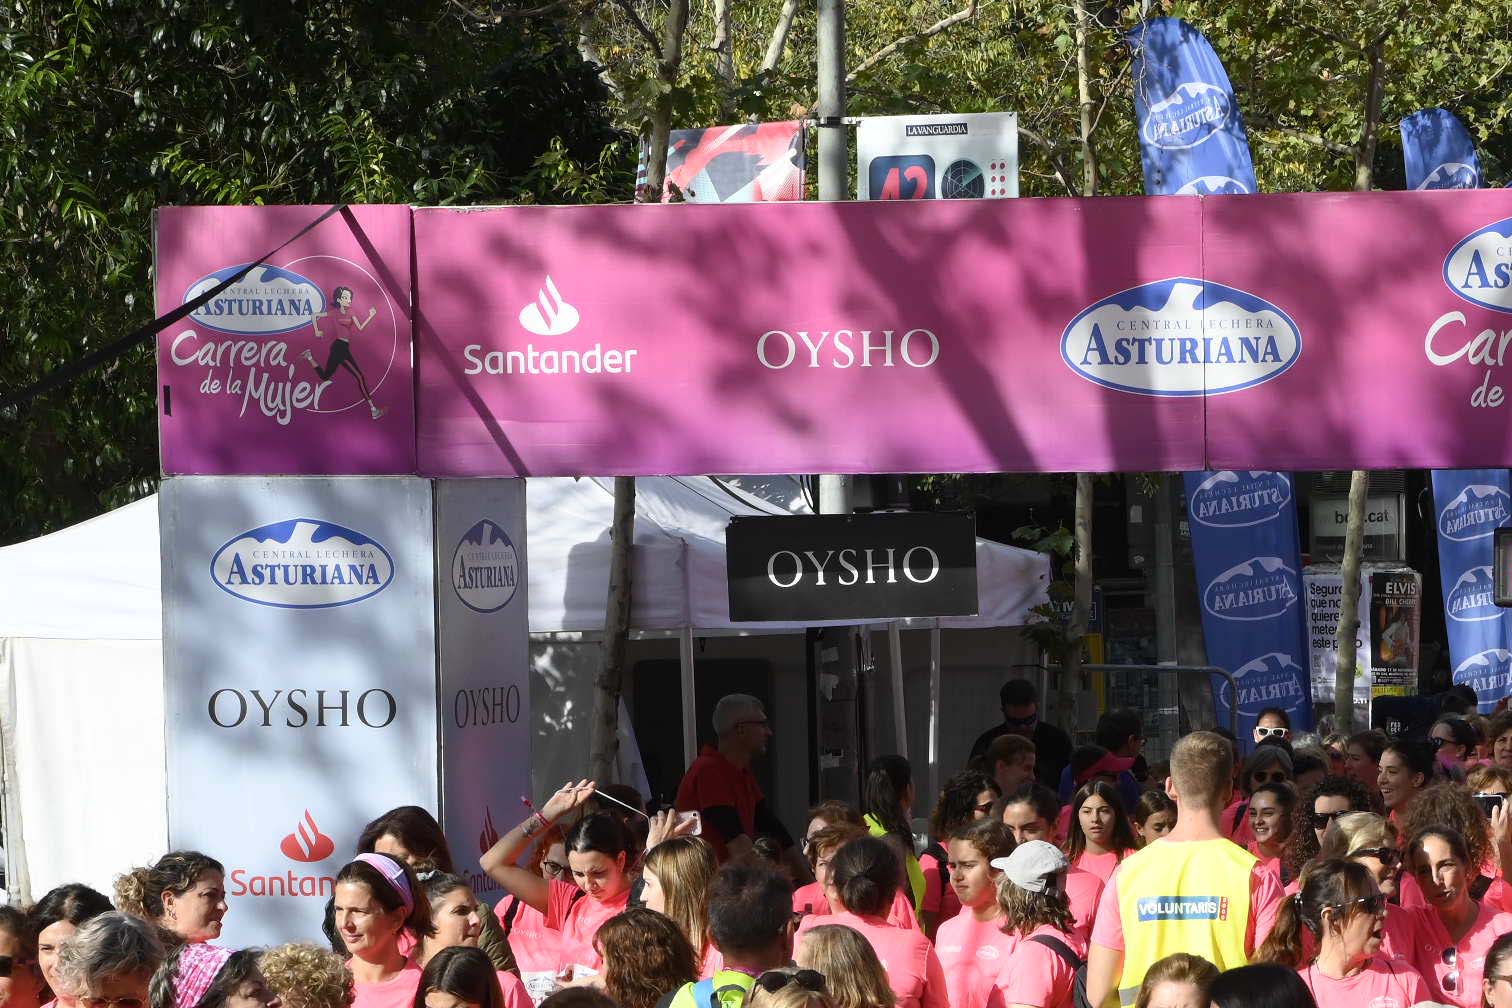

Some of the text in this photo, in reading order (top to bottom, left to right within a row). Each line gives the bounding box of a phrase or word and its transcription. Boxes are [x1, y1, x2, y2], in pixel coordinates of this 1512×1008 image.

[917, 123, 967, 135] VANGUARDIA
[264, 287, 309, 295] LECHERA
[1116, 318, 1275, 331] CENTRAL LECHERA
[170, 329, 288, 368] Carrera
[464, 344, 637, 376] Santander
[757, 328, 940, 370] OYSHO
[1081, 330, 1283, 366] ASTURIANA
[200, 363, 333, 426] de la Mujer
[1470, 371, 1504, 408] de
[225, 552, 381, 586] ASTURIANA
[253, 550, 375, 559] CENTRAL LECHERA
[767, 545, 940, 588] OYSHO
[457, 555, 516, 590] ASTURIANA
[1385, 582, 1416, 595] ELVIS
[1310, 600, 1327, 610] que
[1311, 611, 1344, 624] quiere
[207, 688, 398, 728] OYSHO
[455, 684, 521, 729] OYSHO
[231, 869, 336, 897] Santan
[1138, 902, 1217, 916] VOLUNTARIS
